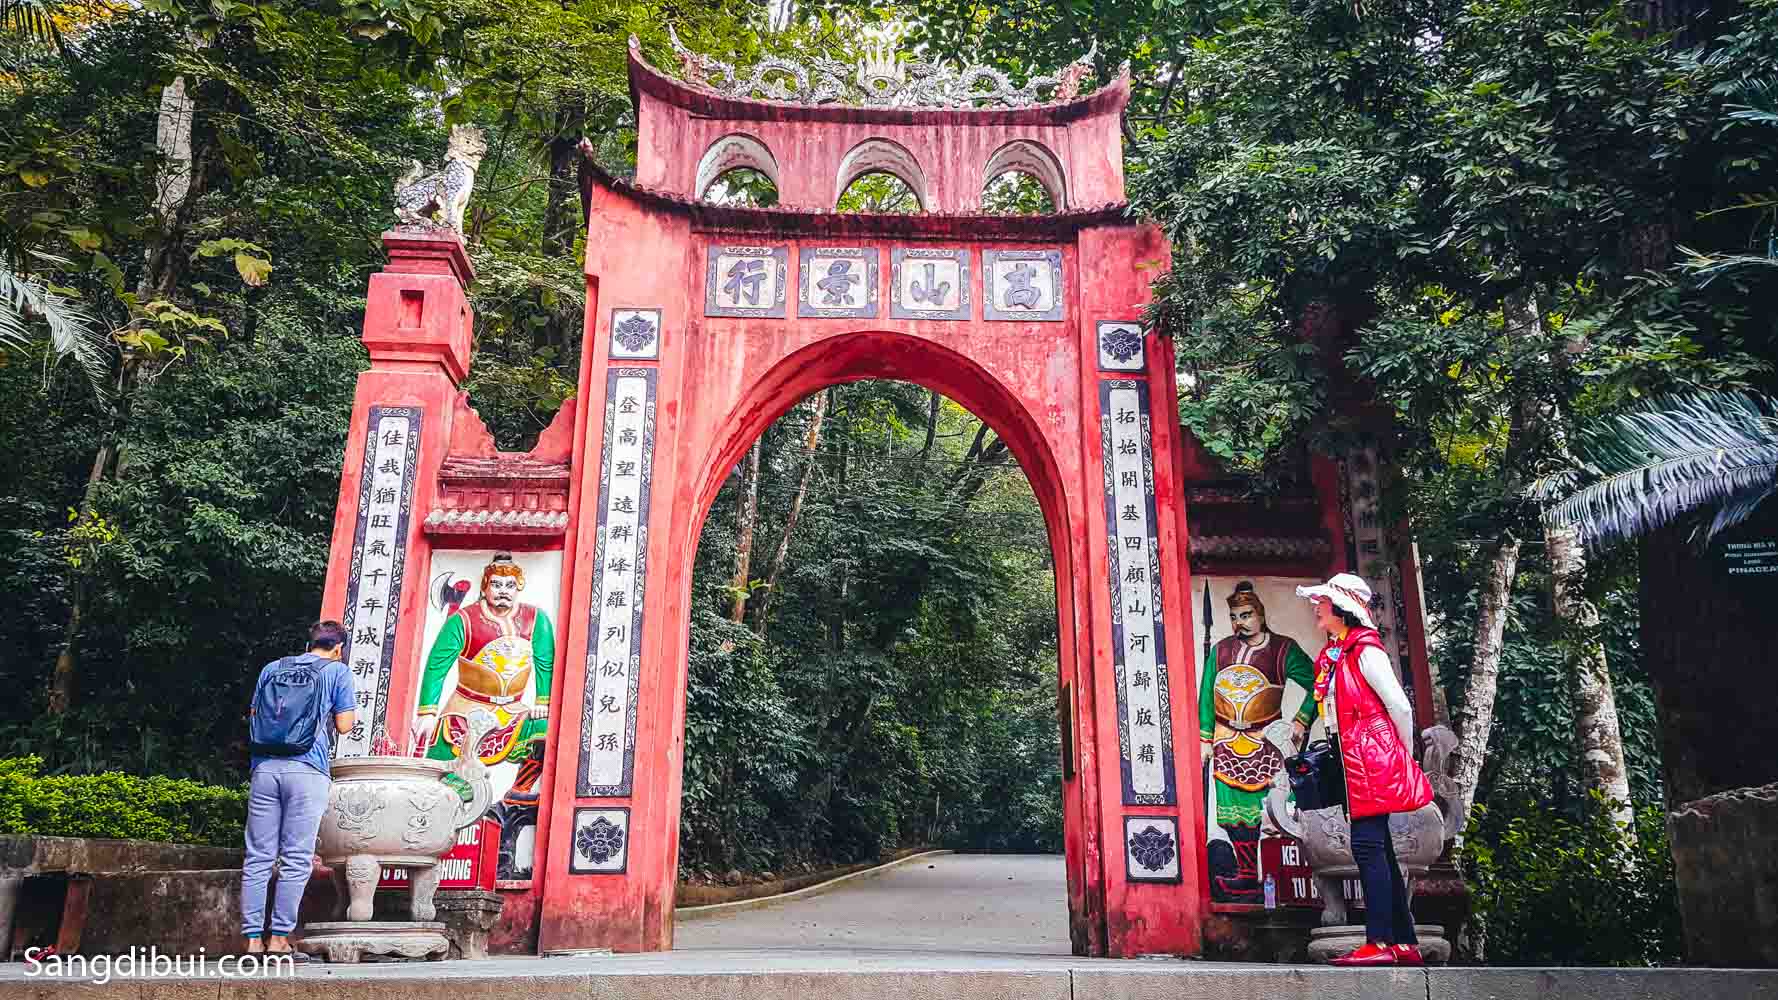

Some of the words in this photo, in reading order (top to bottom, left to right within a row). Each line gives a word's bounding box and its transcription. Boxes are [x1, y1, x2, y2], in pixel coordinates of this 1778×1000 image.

[595, 395, 640, 751] 登高望遠群峰羅列似兒孫
[1115, 407, 1157, 764] 拓始開基四顧山河歸版籍
[440, 853, 472, 881] HÙNG
